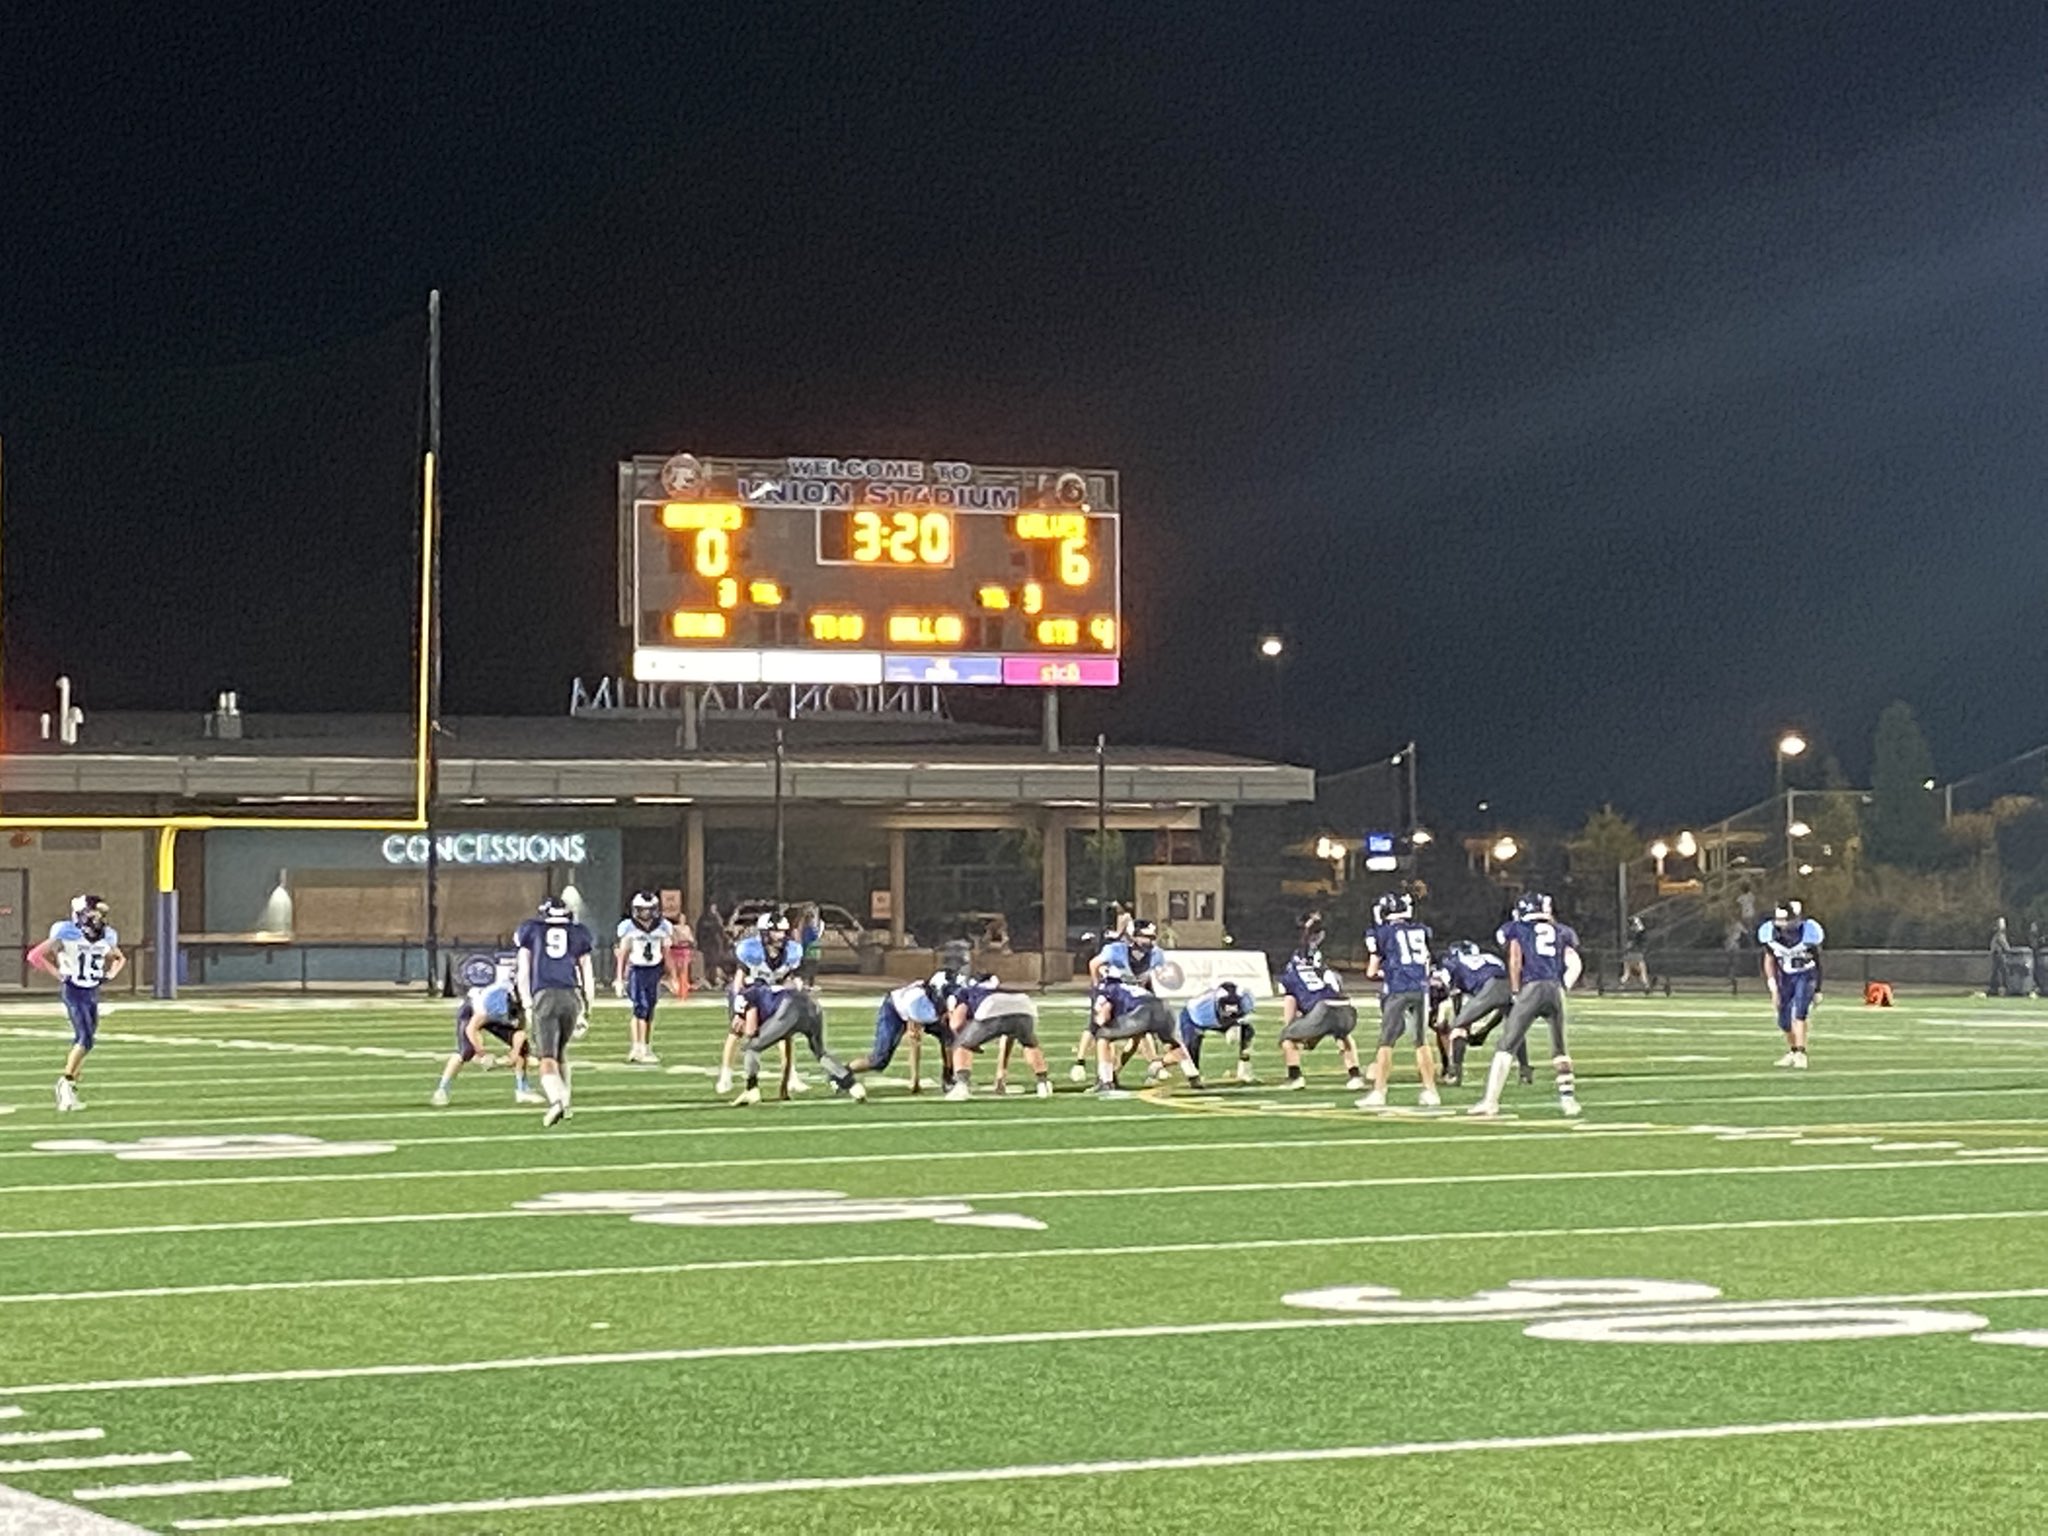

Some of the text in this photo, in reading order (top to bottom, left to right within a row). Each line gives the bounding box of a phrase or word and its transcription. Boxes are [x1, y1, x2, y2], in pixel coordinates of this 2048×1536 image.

[786, 457, 972, 482] WELCOME TO
[738, 479, 1019, 508] UNION STADIUM
[696, 528, 729, 576] 0
[853, 510, 951, 563] 3:20
[1060, 537, 1090, 585] 6
[382, 833, 586, 864] CONCESSIONS
[546, 927, 568, 958] 9
[1534, 923, 1556, 957] 2
[77, 952, 104, 980] 15
